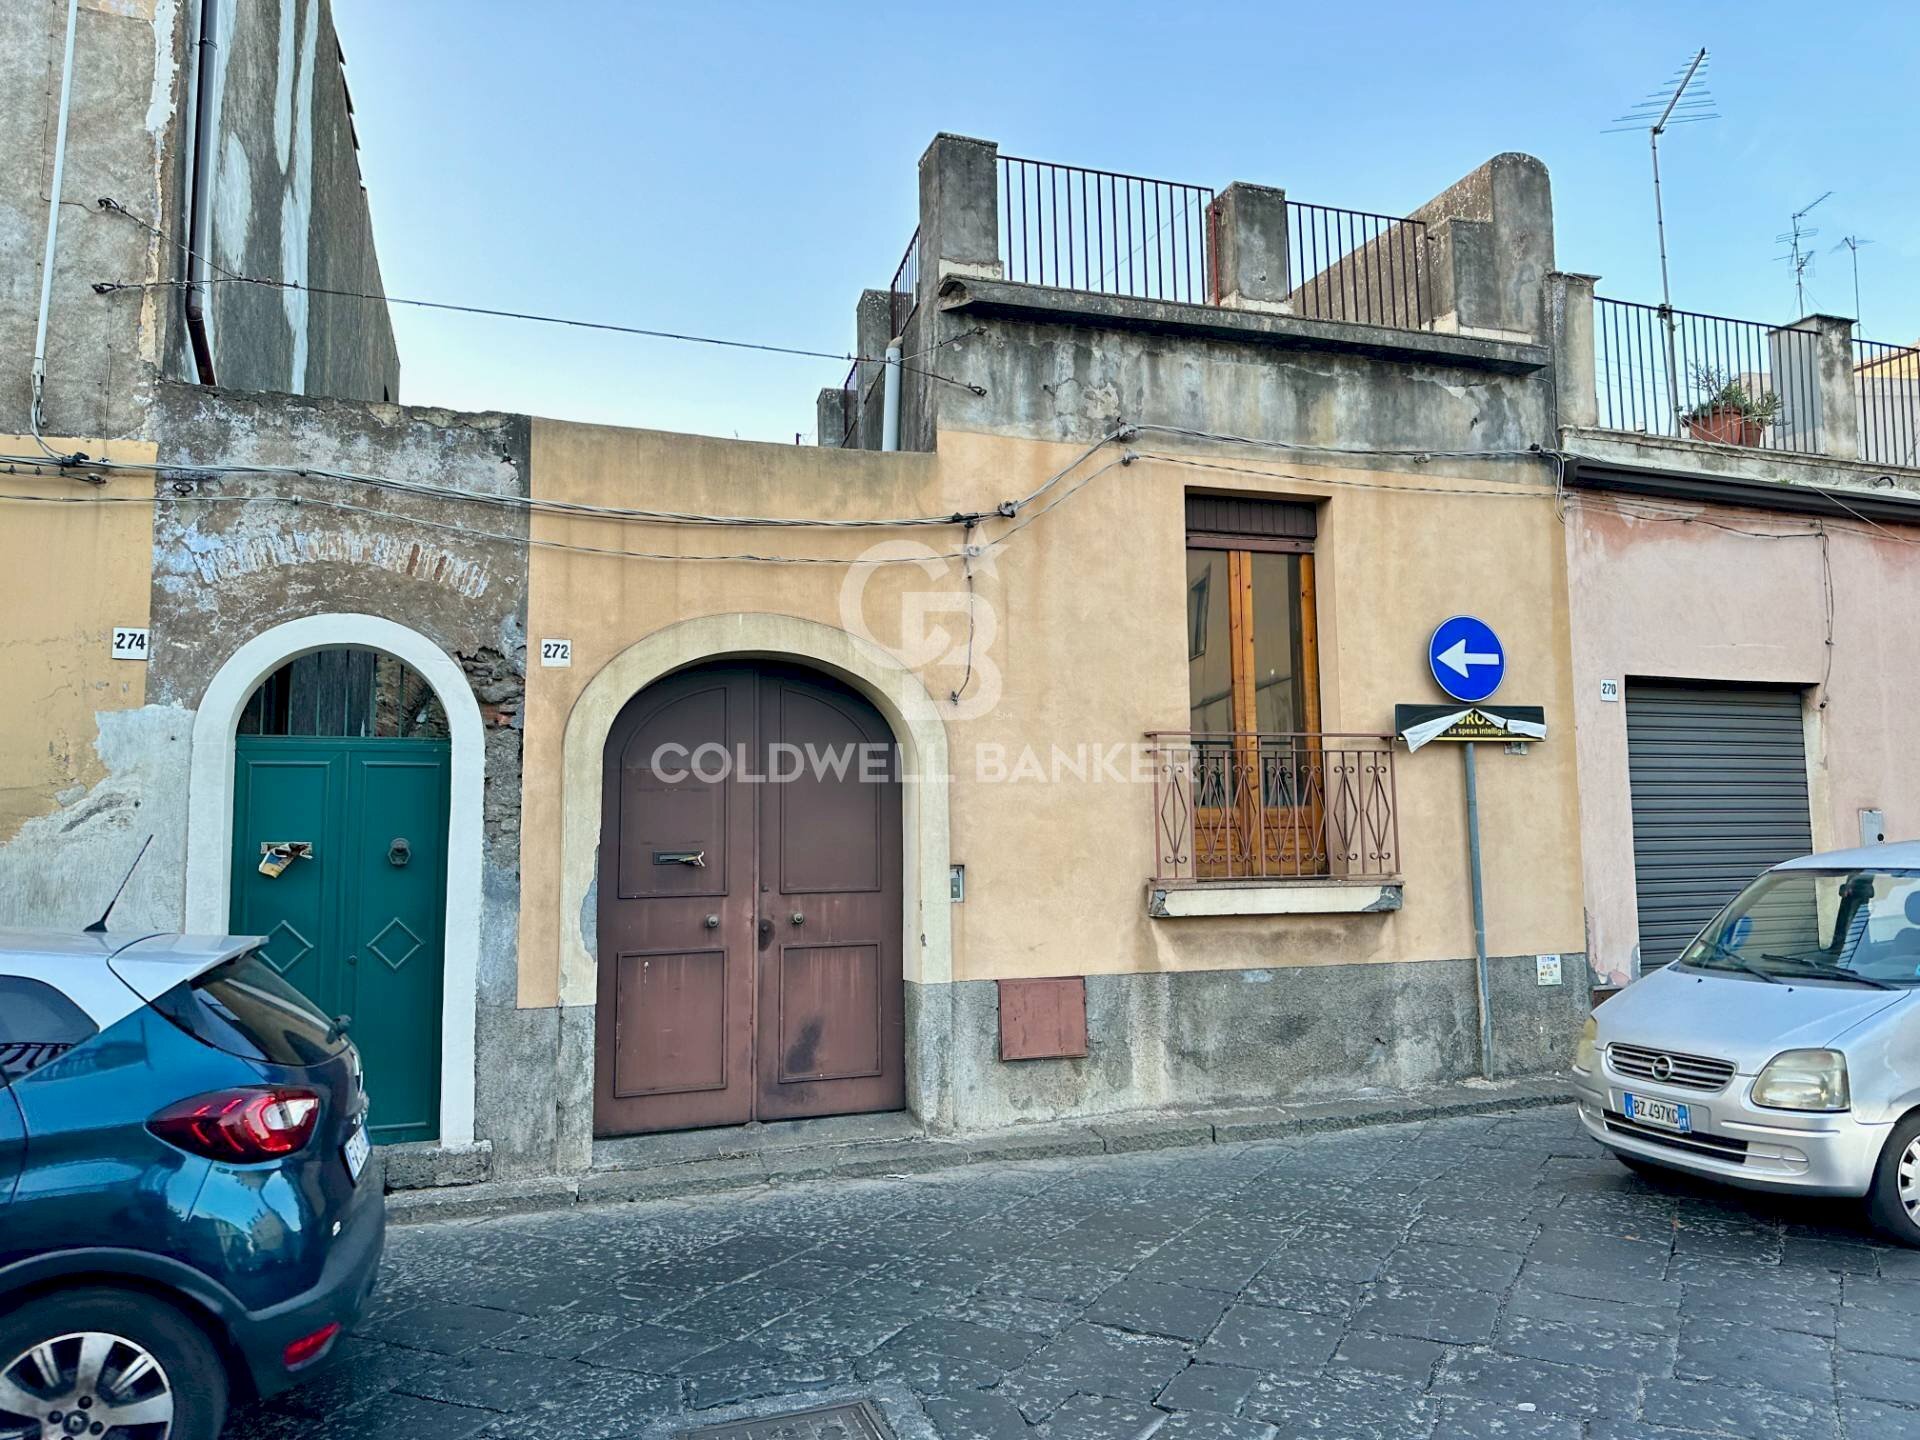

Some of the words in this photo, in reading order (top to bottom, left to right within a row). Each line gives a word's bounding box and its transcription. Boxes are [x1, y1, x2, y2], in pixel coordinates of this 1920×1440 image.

[116, 633, 146, 650] 274
[544, 643, 568, 659] 272
[1602, 683, 1617, 695] 270
[1458, 728, 1478, 736] spesa
[1634, 1100, 1647, 1116] BZ
